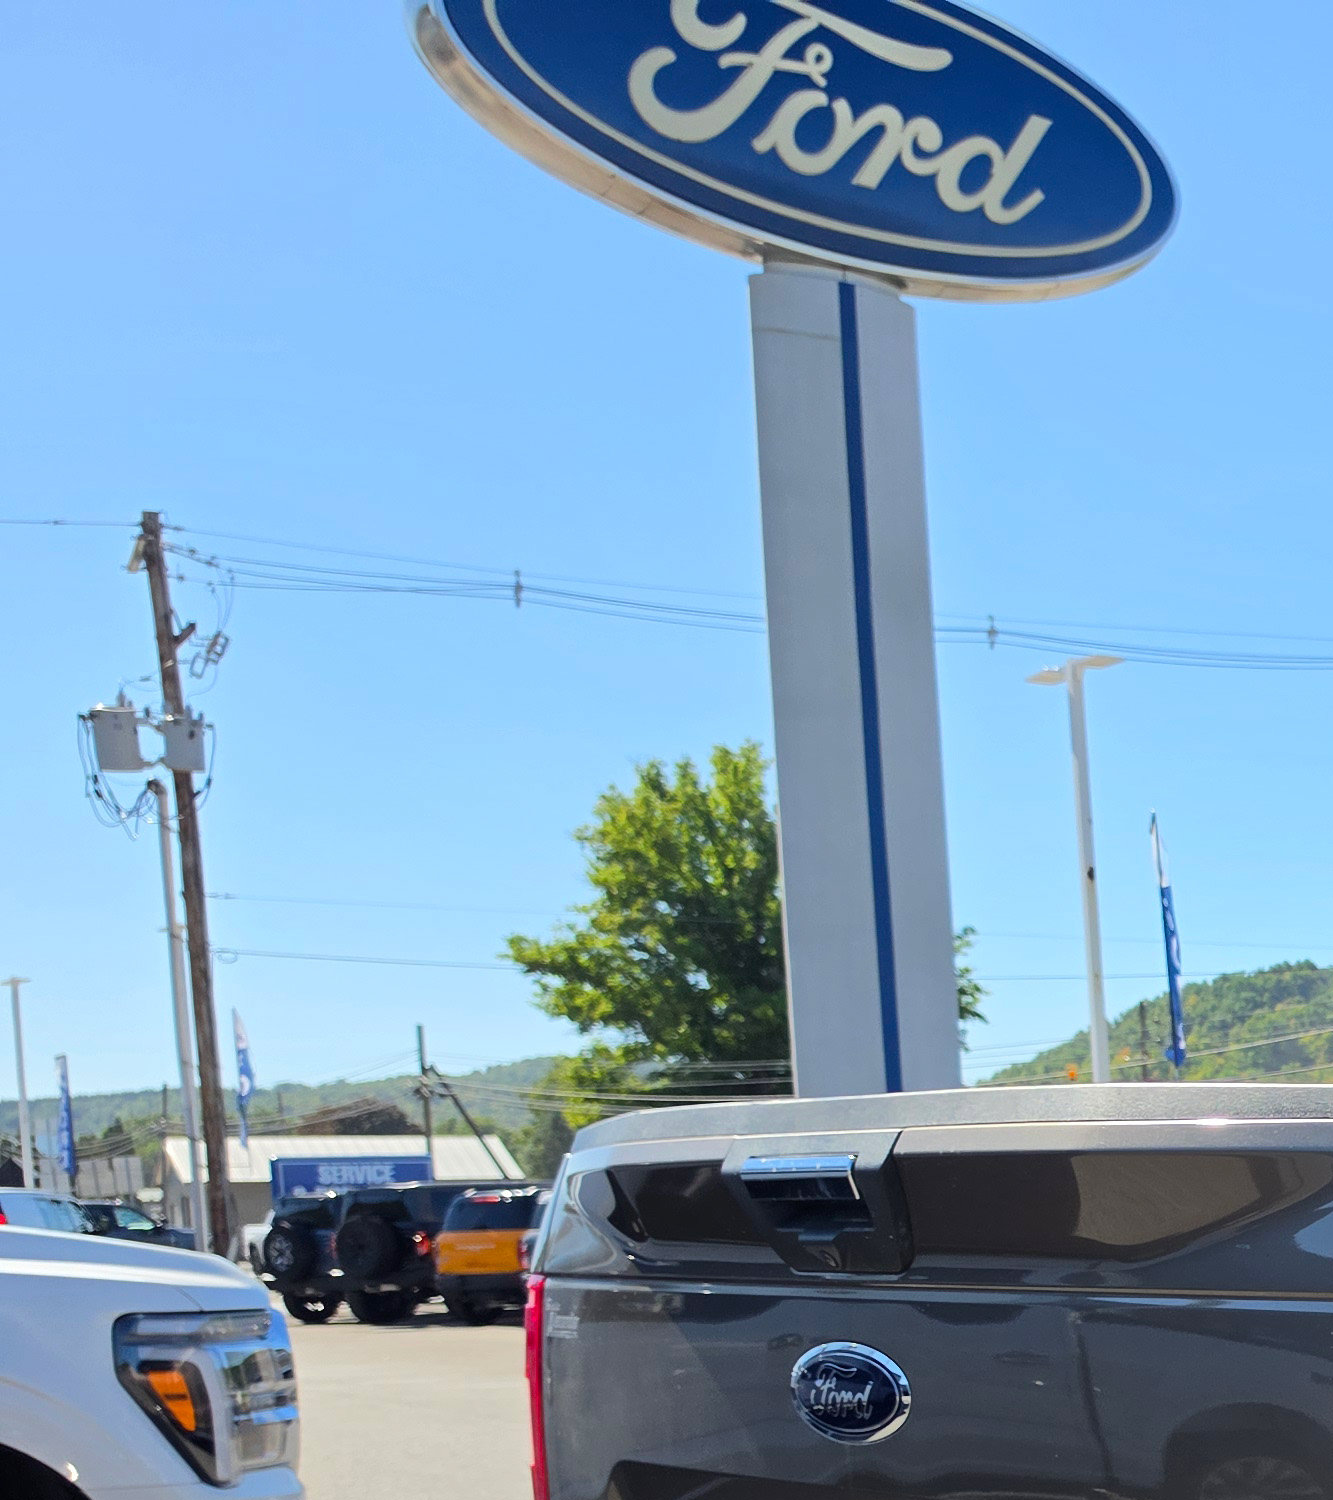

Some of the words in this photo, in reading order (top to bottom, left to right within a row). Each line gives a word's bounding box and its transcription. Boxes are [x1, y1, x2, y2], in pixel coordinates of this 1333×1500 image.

[628, 0, 1053, 225] Ford
[317, 1162, 395, 1185] SERVICE
[809, 1361, 874, 1420] Ford
